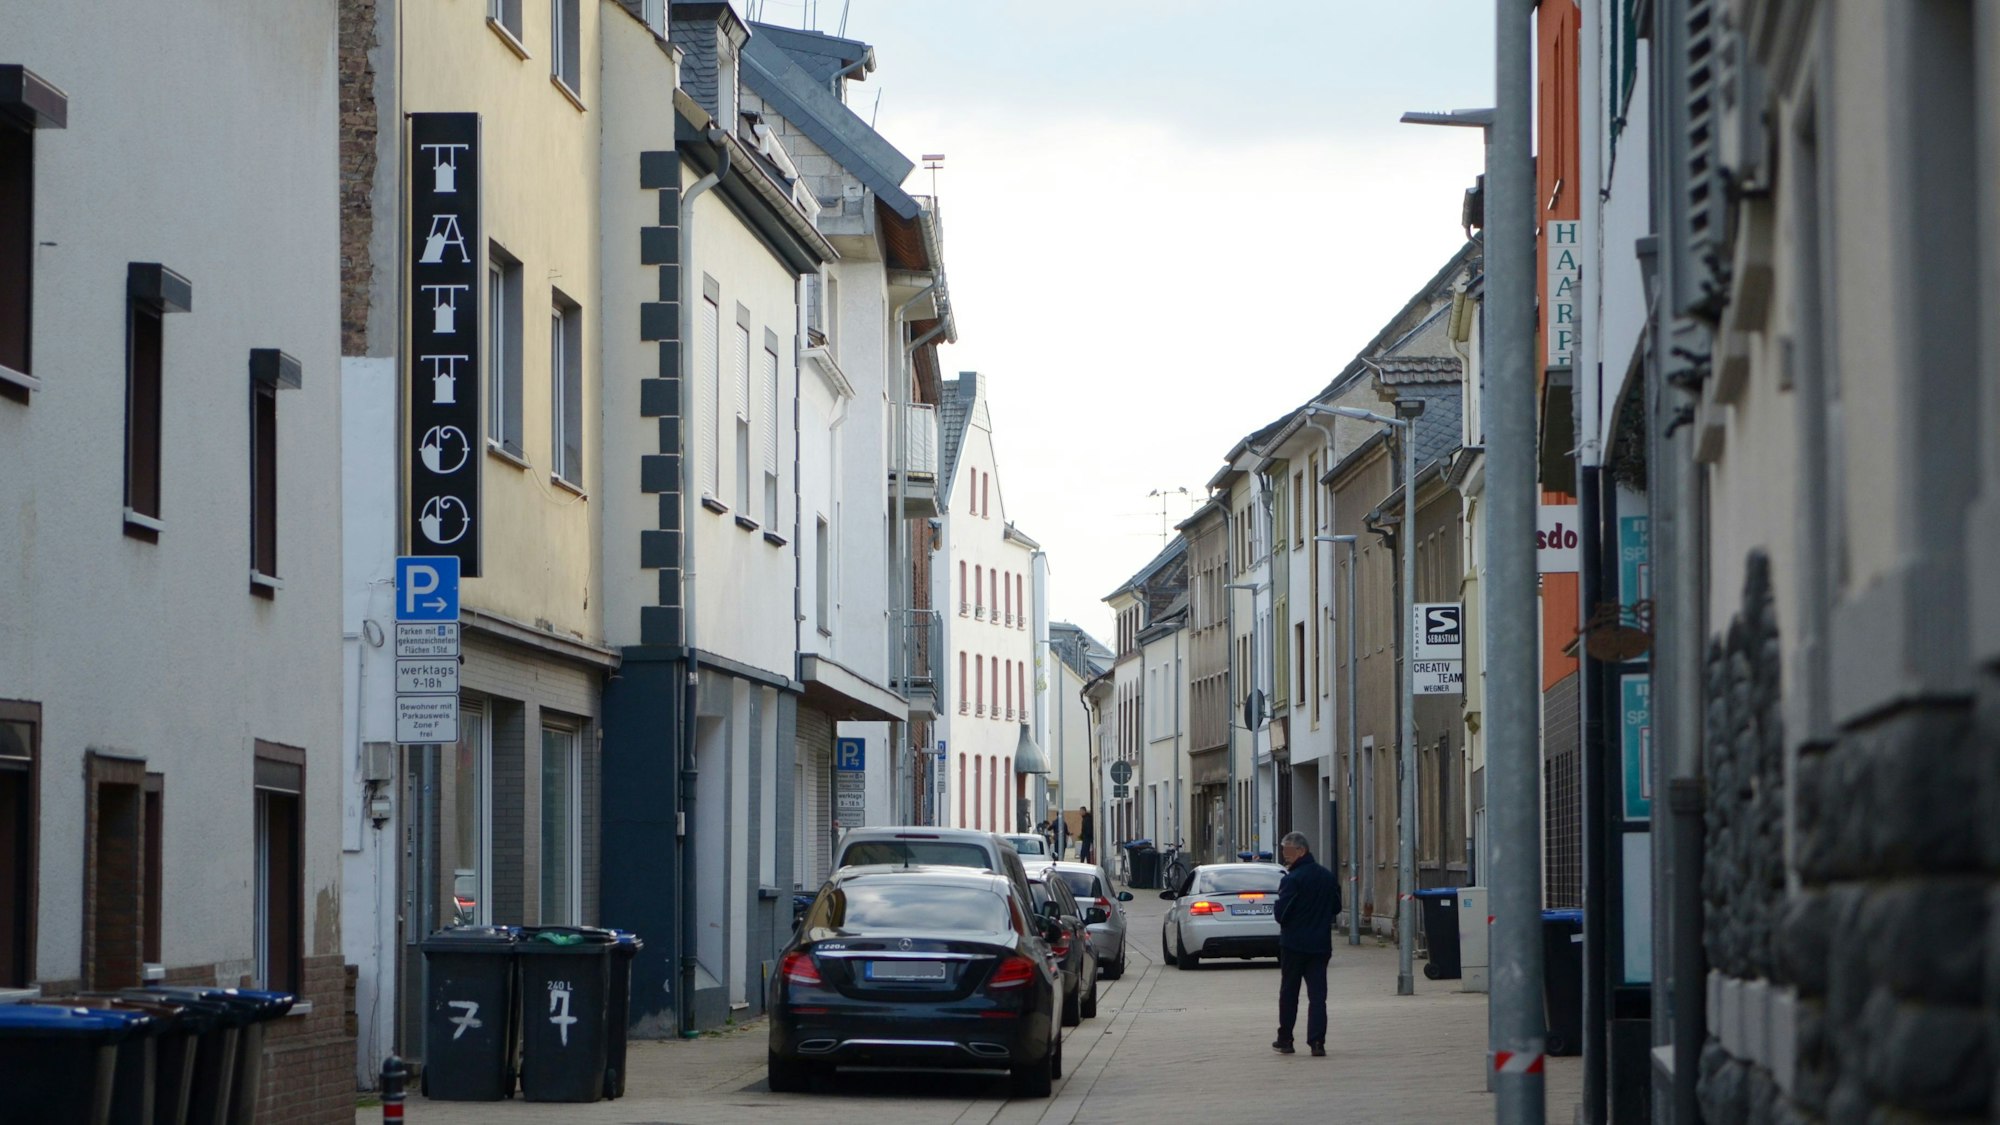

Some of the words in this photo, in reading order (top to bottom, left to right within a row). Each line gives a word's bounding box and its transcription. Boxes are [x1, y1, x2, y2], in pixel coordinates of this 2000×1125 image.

[1556, 223, 1576, 365] HAARP
[418, 143, 470, 544] TATTOO
[406, 565, 439, 613] P
[400, 627, 423, 635] Parken
[425, 627, 436, 635] mit
[447, 627, 454, 635] in
[398, 637, 456, 647] gekennzeichneten
[1427, 634, 1459, 644] SEBASTIAN
[405, 645, 430, 654] Flächen
[401, 665, 454, 678] werktags
[1413, 662, 1451, 673] CREATIV
[1438, 673, 1463, 684] TEAM
[1423, 684, 1450, 693] WEGNER
[400, 703, 438, 711] Bewohner
[402, 712, 450, 720] Parkausweis
[413, 721, 433, 729] Zone
[419, 730, 433, 738] frei
[842, 742, 858, 767] P
[448, 1000, 483, 1041] 7
